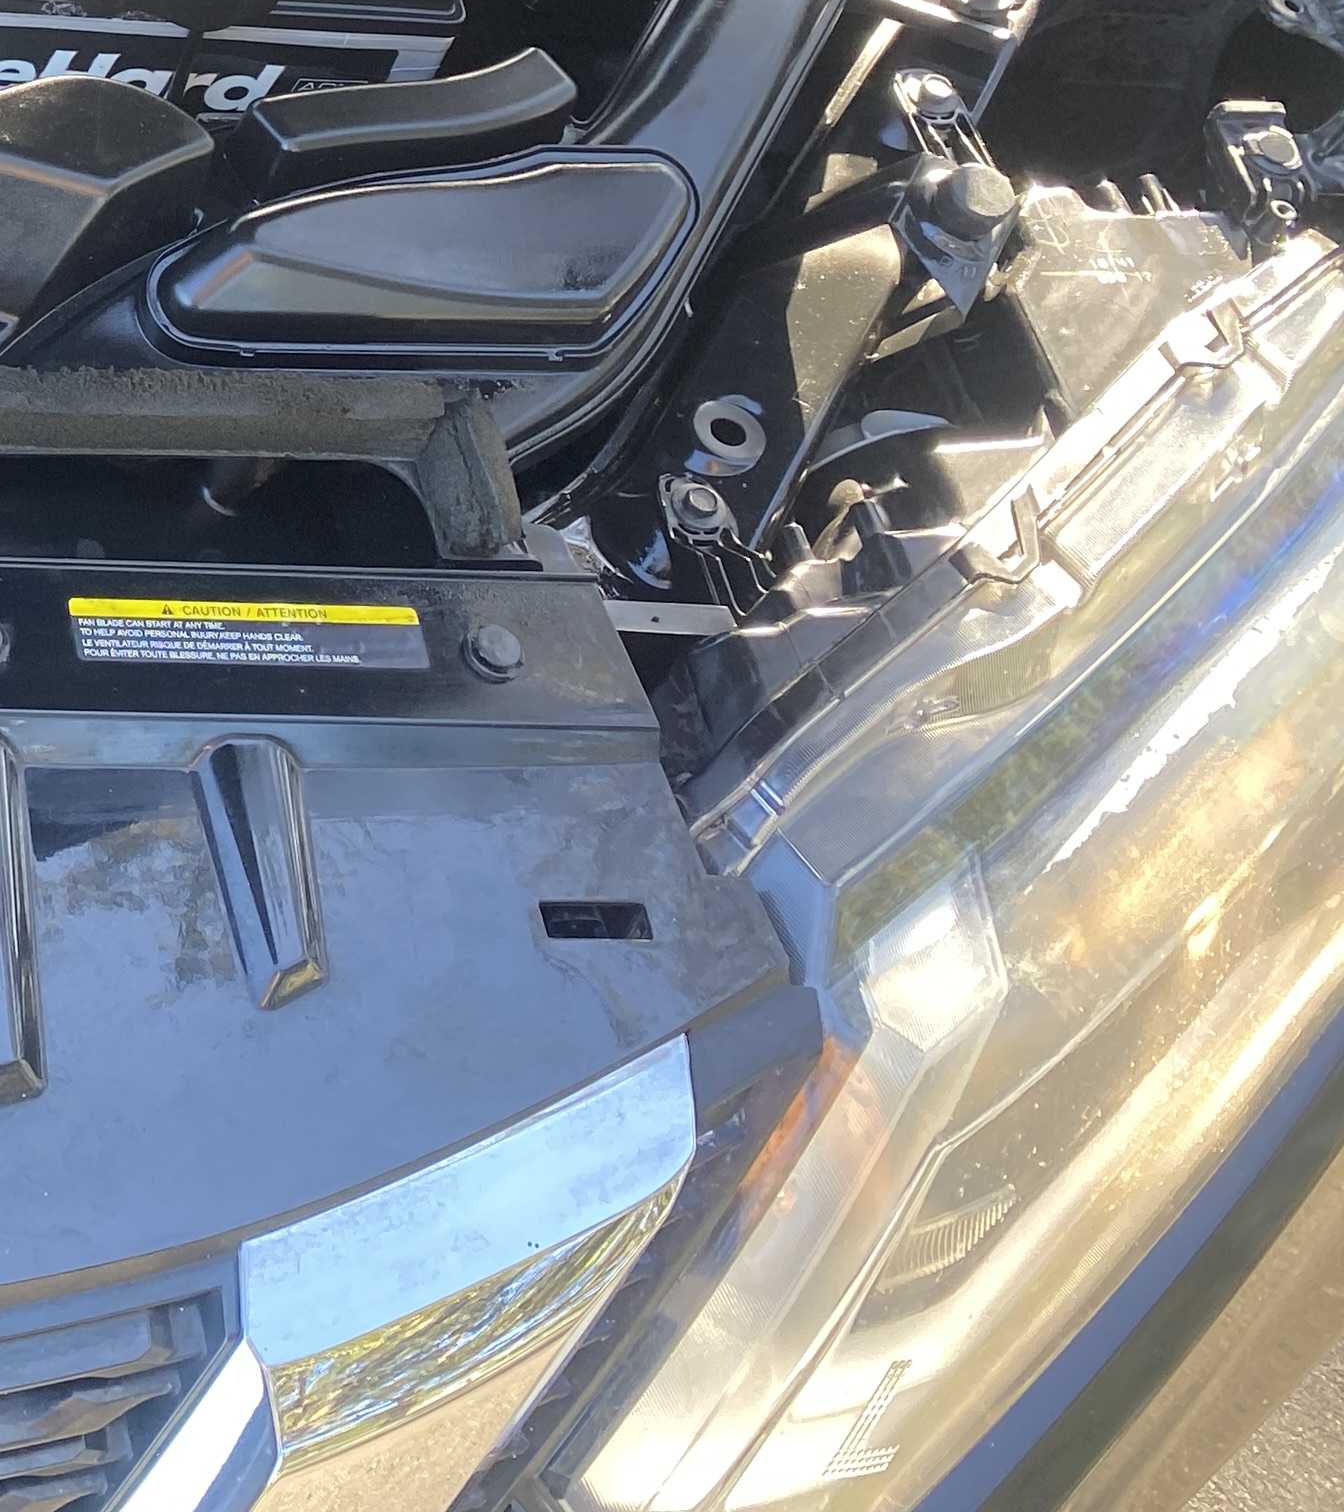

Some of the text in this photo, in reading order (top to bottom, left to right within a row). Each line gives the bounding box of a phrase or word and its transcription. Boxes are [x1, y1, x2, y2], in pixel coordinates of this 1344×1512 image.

[182, 605, 328, 619] CAUTION / ATTENTION
[78, 618, 95, 627] FAN
[96, 619, 125, 627] BLADE
[125, 619, 144, 628] CAN
[145, 620, 172, 628] START
[185, 621, 205, 629] ANY
[79, 628, 93, 636] TO
[93, 628, 116, 636] HELP
[116, 629, 144, 637] AVOID
[144, 630, 191, 639] PERSONAL
[242, 633, 273, 641] HANDS
[273, 633, 305, 641] CLEAR.
[81, 639, 315, 653] LE VENTILATEUR RISQUE DE DÉMARRER À TOUT MOMENT.
[83, 649, 110, 657] POUR
[110, 648, 140, 658] ÉVITER
[140, 650, 169, 659] TOUTE
[216, 652, 229, 661] NE
[229, 653, 247, 661] PAS
[248, 653, 261, 661] EN
[261, 654, 315, 663] APPROCHER
[315, 655, 332, 664] LES
[332, 655, 362, 664] MAINS.
